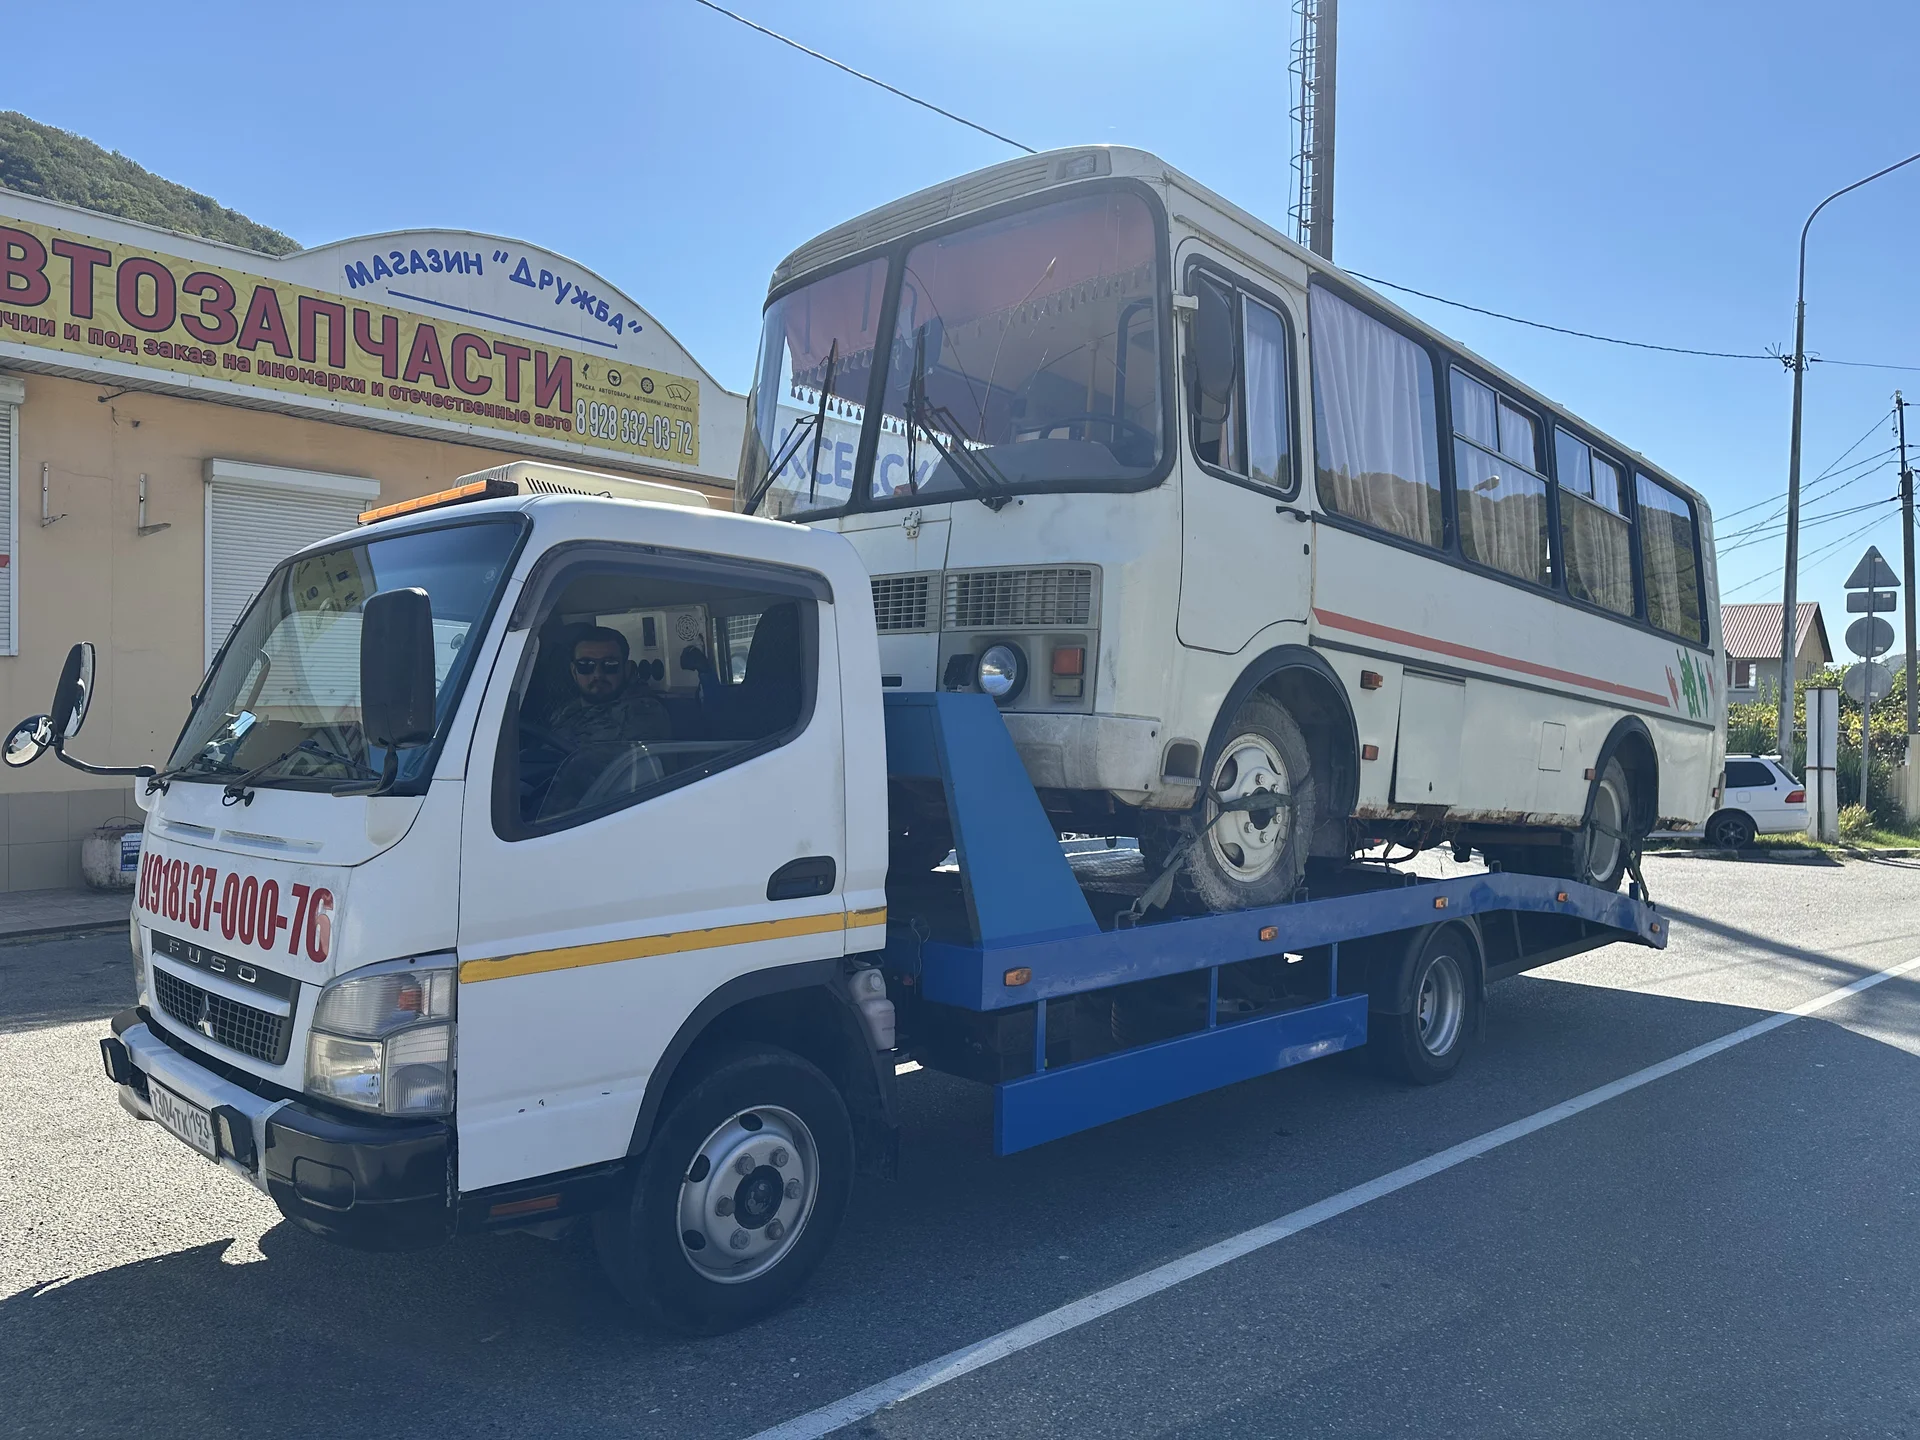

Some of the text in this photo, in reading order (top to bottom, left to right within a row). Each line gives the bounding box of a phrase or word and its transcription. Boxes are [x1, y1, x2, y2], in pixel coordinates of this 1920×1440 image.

[0, 310, 573, 432] чии и под заказ на иномарки и отечественные авто
[575, 382, 596, 391] КРАСКА
[598, 387, 631, 399] АВТОТОВАРЫ
[576, 397, 694, 456] 8 928 332-03-72
[169, 939, 257, 983] FUSO
